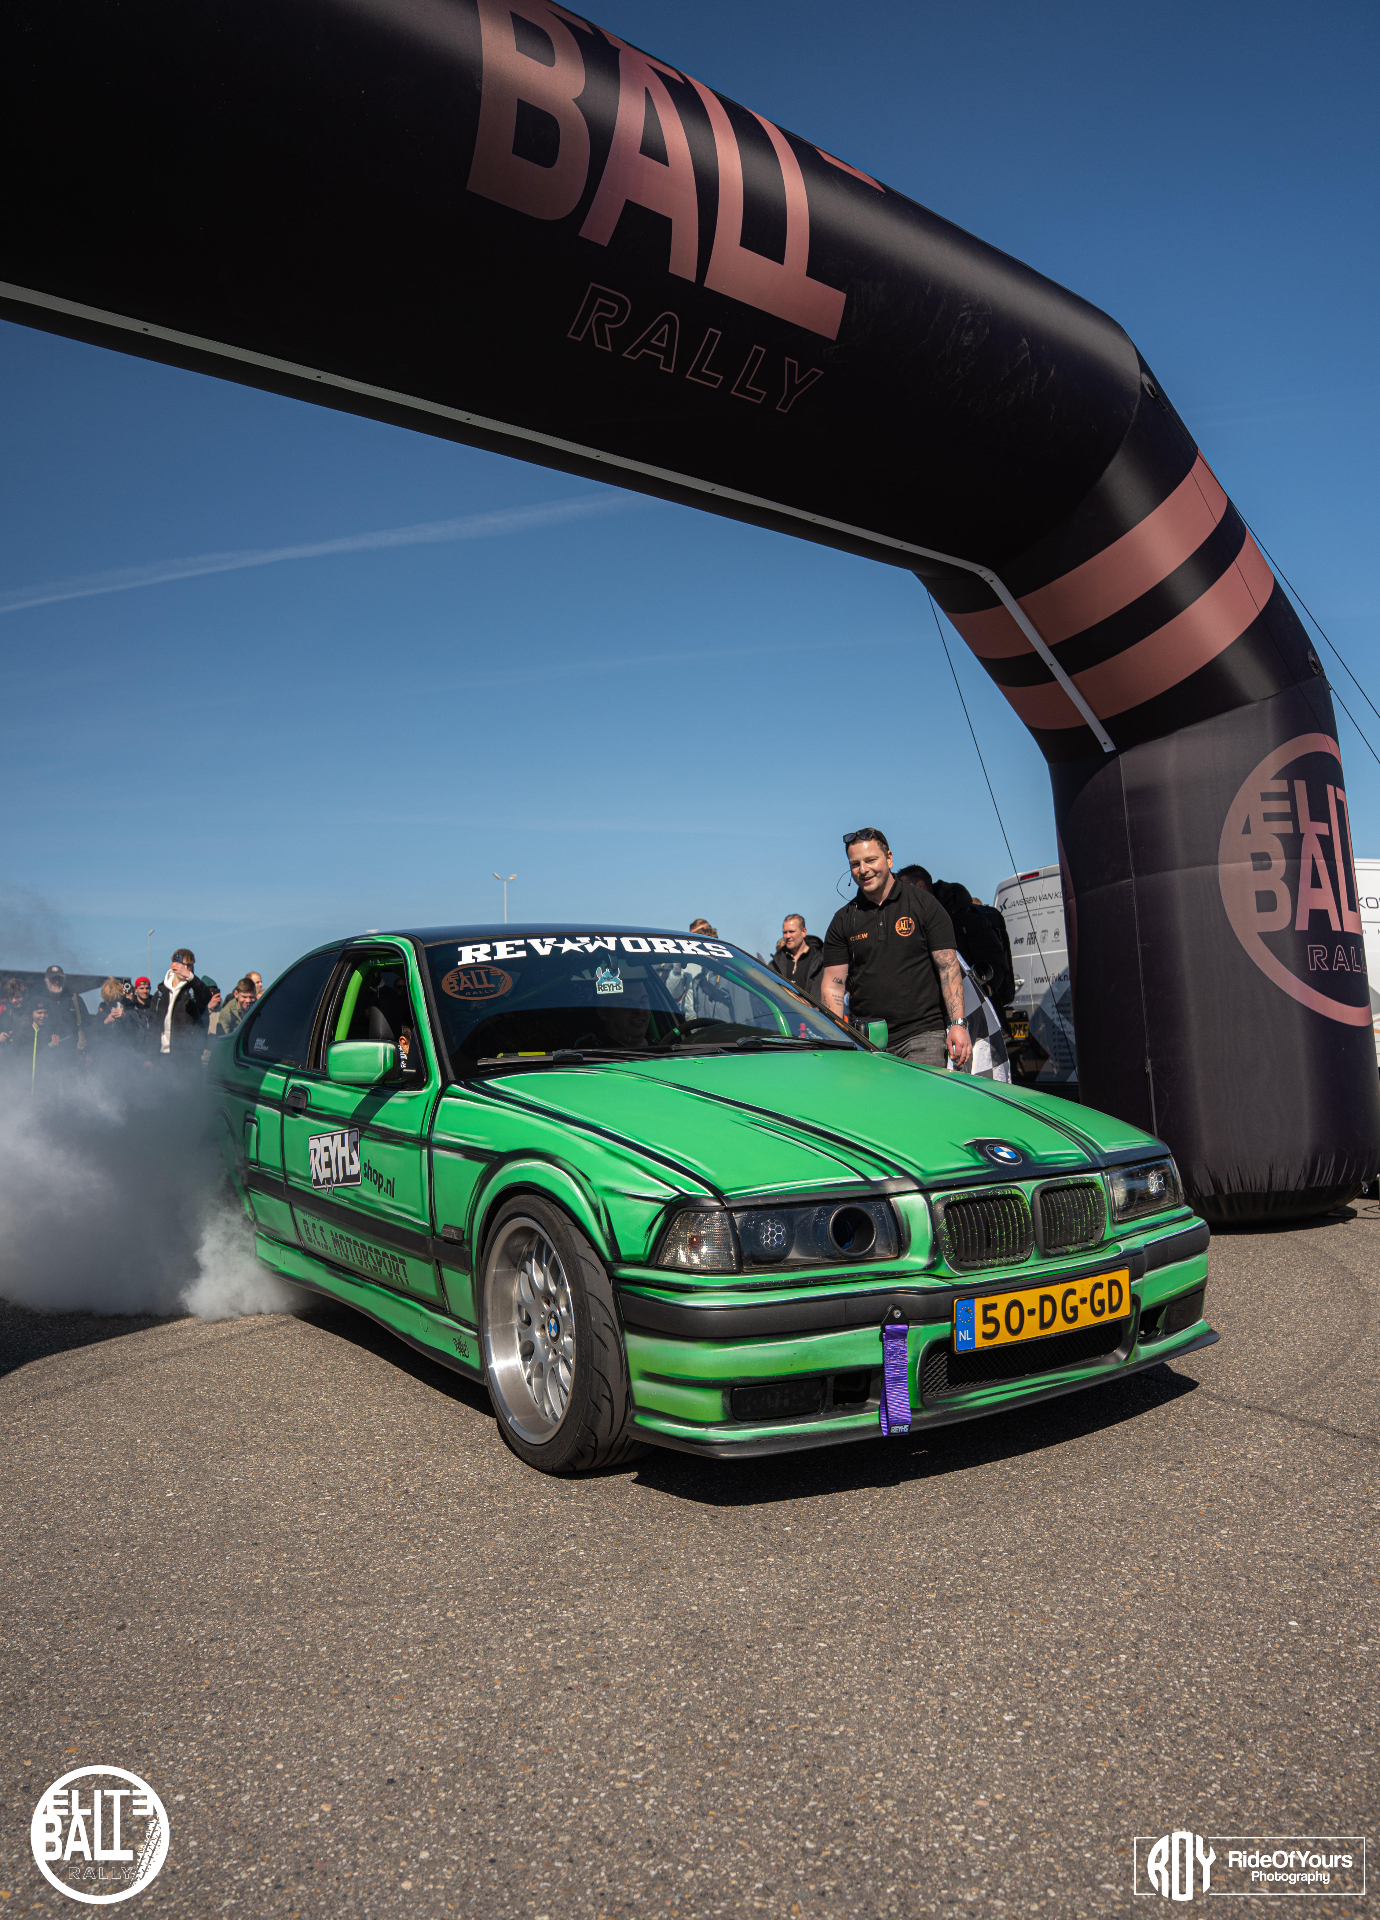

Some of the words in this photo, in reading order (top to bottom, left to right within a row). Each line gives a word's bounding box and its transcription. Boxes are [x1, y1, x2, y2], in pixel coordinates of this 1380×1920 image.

[567, 282, 824, 413] RALLY
[1039, 892, 1053, 902] VAN
[1359, 896, 1380, 909] KO
[457, 937, 557, 966] REV
[574, 935, 734, 958] WORKS
[1307, 944, 1367, 974] RALL
[309, 1132, 360, 1184] REYHS
[363, 1159, 395, 1199] shop.nl
[330, 1230, 410, 1287] MOTORSPORT
[981, 1278, 1124, 1341] 50-DG-GD
[958, 1330, 973, 1342] NL
